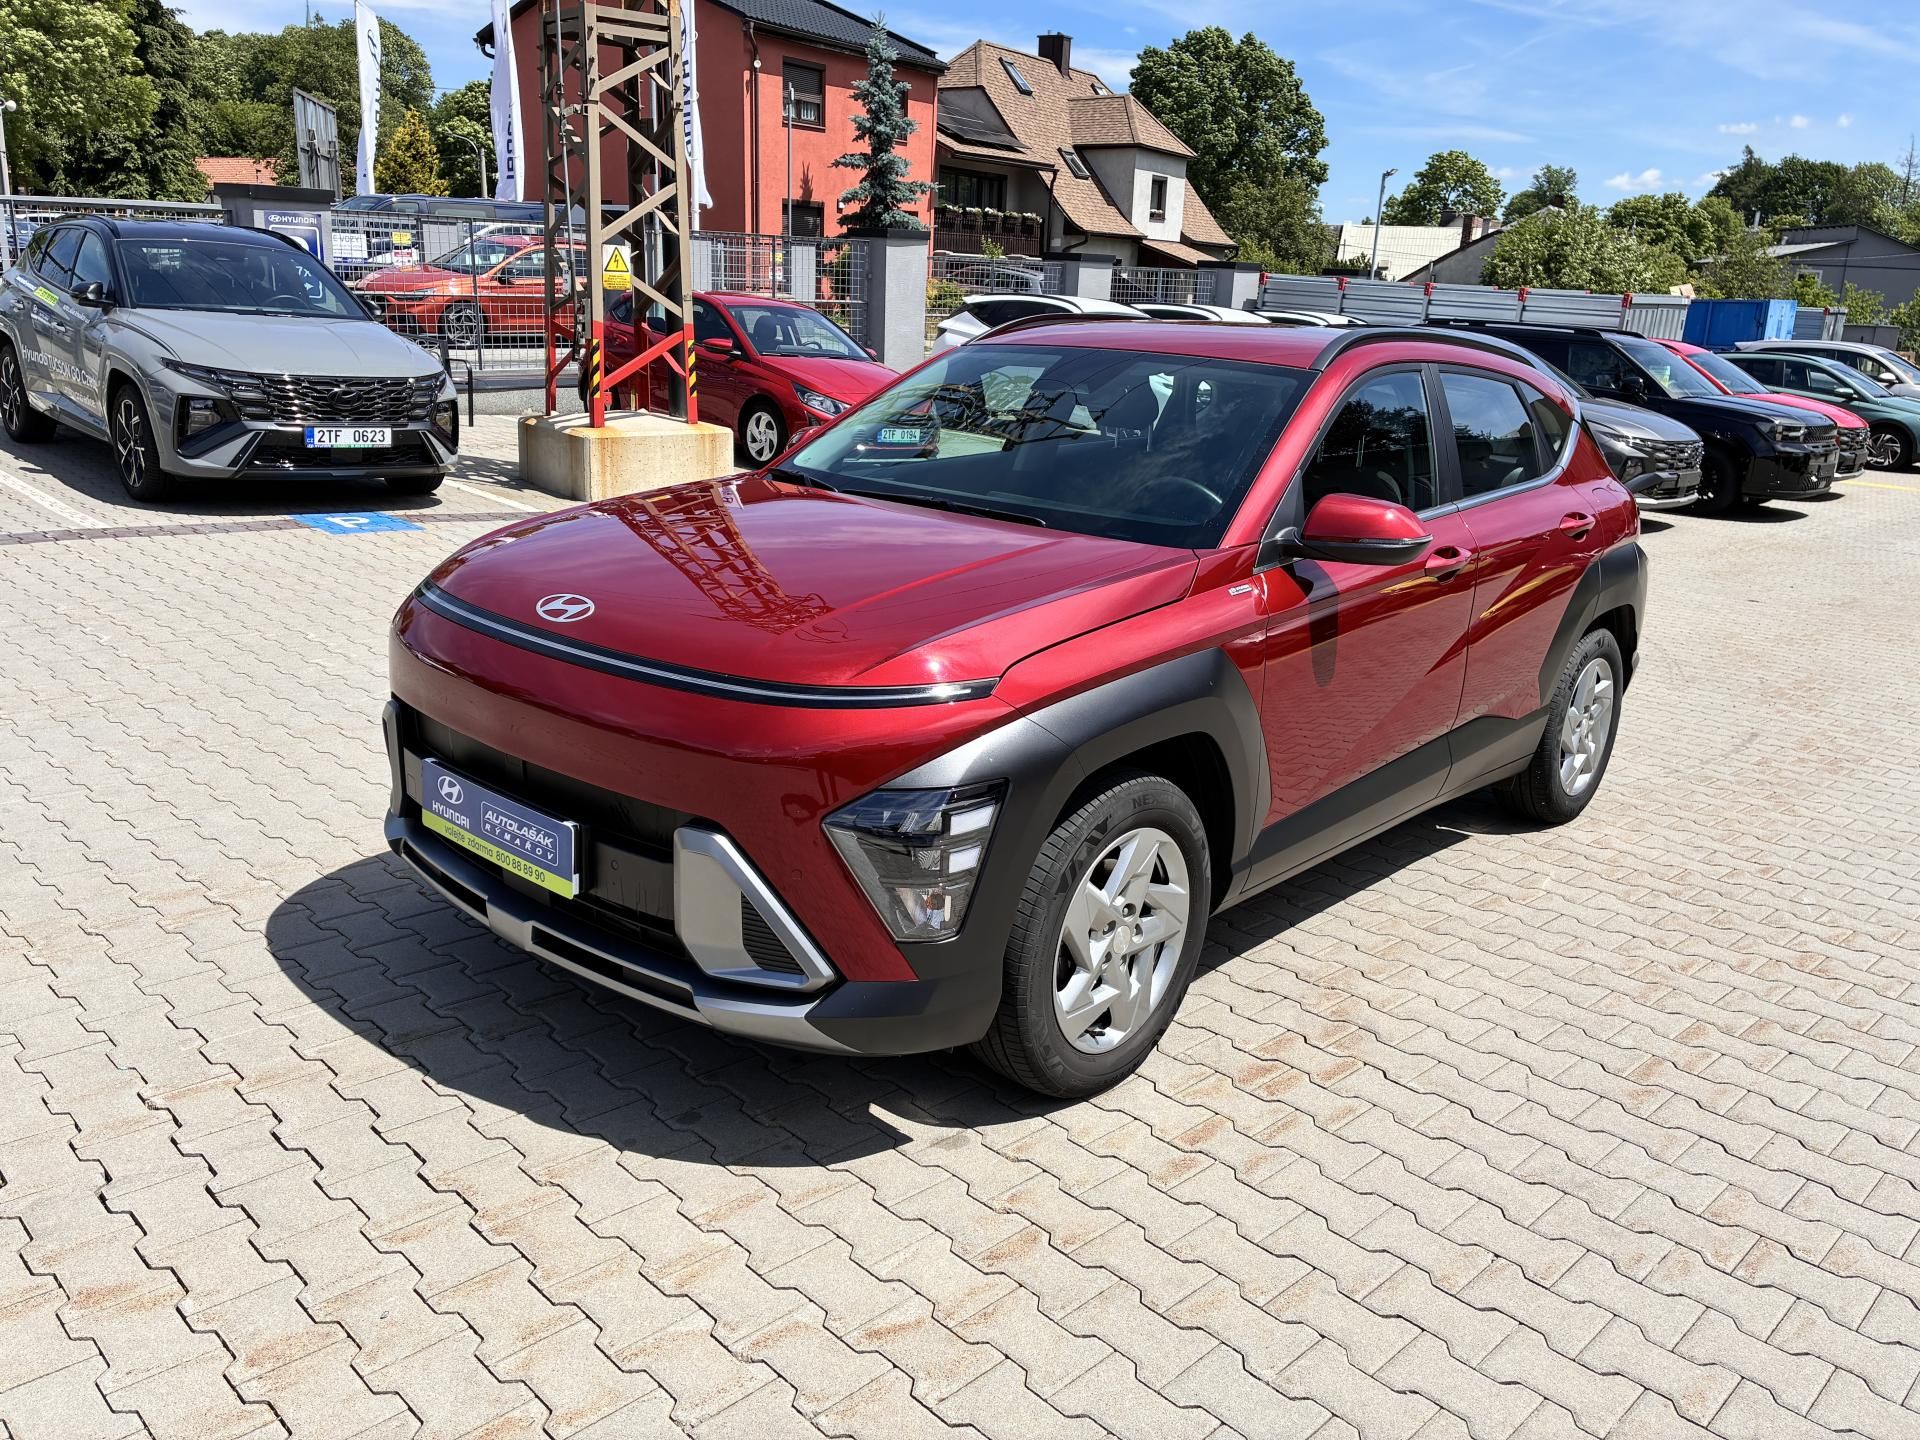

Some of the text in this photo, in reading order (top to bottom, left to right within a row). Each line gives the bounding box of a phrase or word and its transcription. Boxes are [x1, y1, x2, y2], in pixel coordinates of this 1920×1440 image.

[282, 215, 317, 224] HYUNDAI
[71, 366, 80, 381] GO
[317, 430, 386, 443] 2TF 0623
[883, 429, 896, 439] 2TF
[1567, 652, 1588, 691] NEXEN
[432, 800, 470, 830] HYUNDAI
[484, 810, 553, 848] AUTOLAŠÁK
[444, 824, 546, 883] volejte zdarma 800 88 89 90
